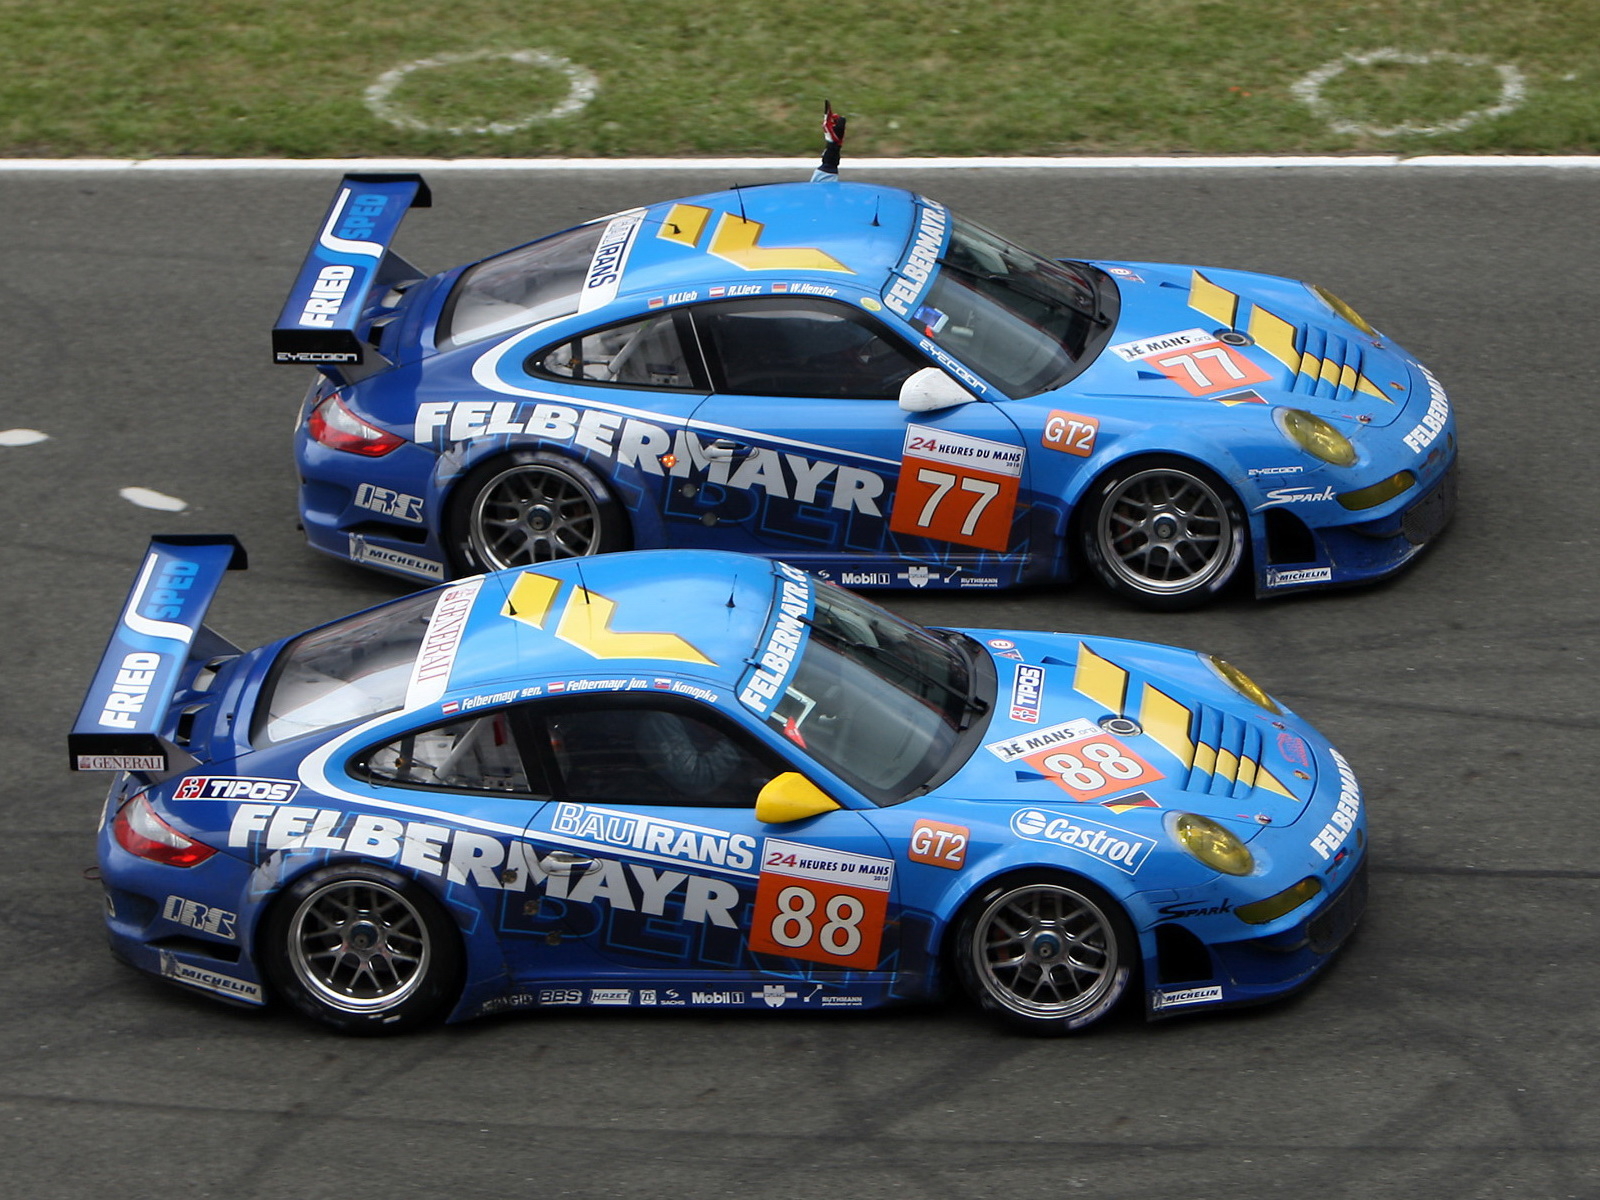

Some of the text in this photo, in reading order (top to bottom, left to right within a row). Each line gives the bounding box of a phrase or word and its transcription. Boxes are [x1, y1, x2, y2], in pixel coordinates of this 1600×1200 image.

[338, 194, 389, 239] SPED
[298, 265, 355, 328] FRIED
[667, 291, 698, 305] M.Lieb
[727, 285, 762, 296] R.Lietz
[790, 283, 837, 297] W.Henzler
[1145, 335, 1191, 352] MANS
[1158, 347, 1246, 387] 77
[1044, 416, 1097, 450] GT2
[414, 401, 884, 518] FELBERMAYR
[908, 437, 1021, 462] 24 HEURES DU MANS
[917, 467, 1001, 536] 77
[368, 549, 440, 573] MICHELIN
[841, 572, 877, 585] Mobil
[1279, 569, 1328, 581] MICHELIN
[144, 560, 199, 621] SPED
[417, 599, 471, 685] GENERALI
[98, 652, 161, 729] FRIED
[566, 677, 648, 692] Felbermayr jun.
[672, 681, 718, 703] Konopka
[1016, 667, 1040, 705] TIPOS
[461, 686, 543, 711] Felbermayr sen.
[1025, 728, 1075, 749] MANS
[93, 757, 162, 769] GENERALI
[1042, 742, 1144, 791] 88
[210, 780, 292, 800] TIPOS
[911, 826, 967, 863] GT2
[1043, 816, 1143, 867] Castrol
[228, 803, 740, 930] FELBERMAYR
[765, 852, 890, 876] 24 HEURES DU MANS
[770, 885, 865, 956] 88
[179, 966, 258, 995] MICHELIN
[540, 989, 583, 1005] BBS
[592, 992, 628, 1000] HAZET
[692, 991, 730, 1004] Mobil
[1166, 988, 1219, 1002] MICHELIN
